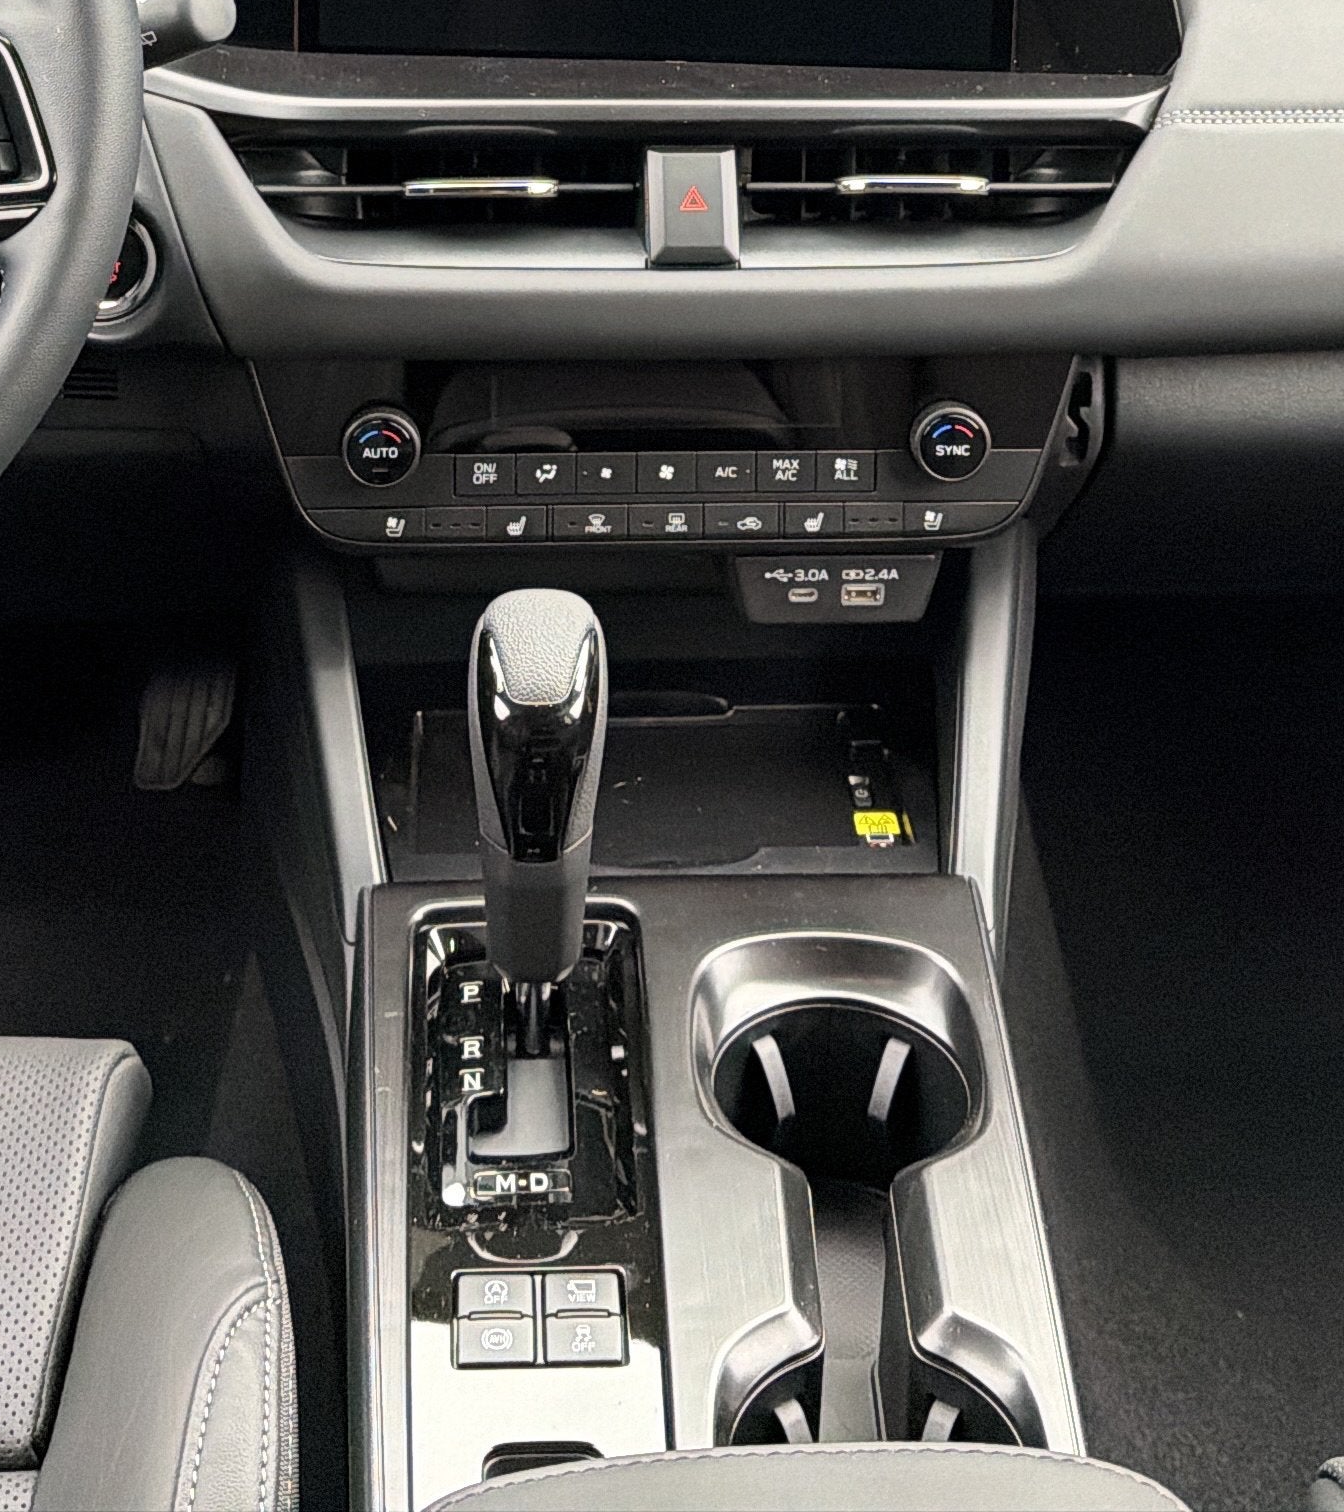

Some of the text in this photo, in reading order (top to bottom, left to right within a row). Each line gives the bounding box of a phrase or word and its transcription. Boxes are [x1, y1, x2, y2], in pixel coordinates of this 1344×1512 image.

[362, 447, 399, 459] AUTO
[935, 444, 971, 457] SYNC
[473, 462, 497, 474] ON/
[772, 459, 800, 470] MAX
[714, 466, 738, 478] A/C
[775, 470, 798, 481] A/C
[834, 469, 858, 481] ALL
[472, 473, 498, 485] OFF
[584, 525, 612, 533] FRONT
[665, 524, 688, 533] REAR
[794, 569, 829, 582] 3.0A
[864, 568, 899, 581] 2.4A
[463, 985, 479, 997] P
[463, 1040, 481, 1057] R
[464, 1072, 481, 1089] N
[495, 1173, 548, 1192] M D
[484, 1294, 508, 1304] OFF
[568, 1293, 596, 1303] VIEW
[571, 1341, 595, 1352] OFF
